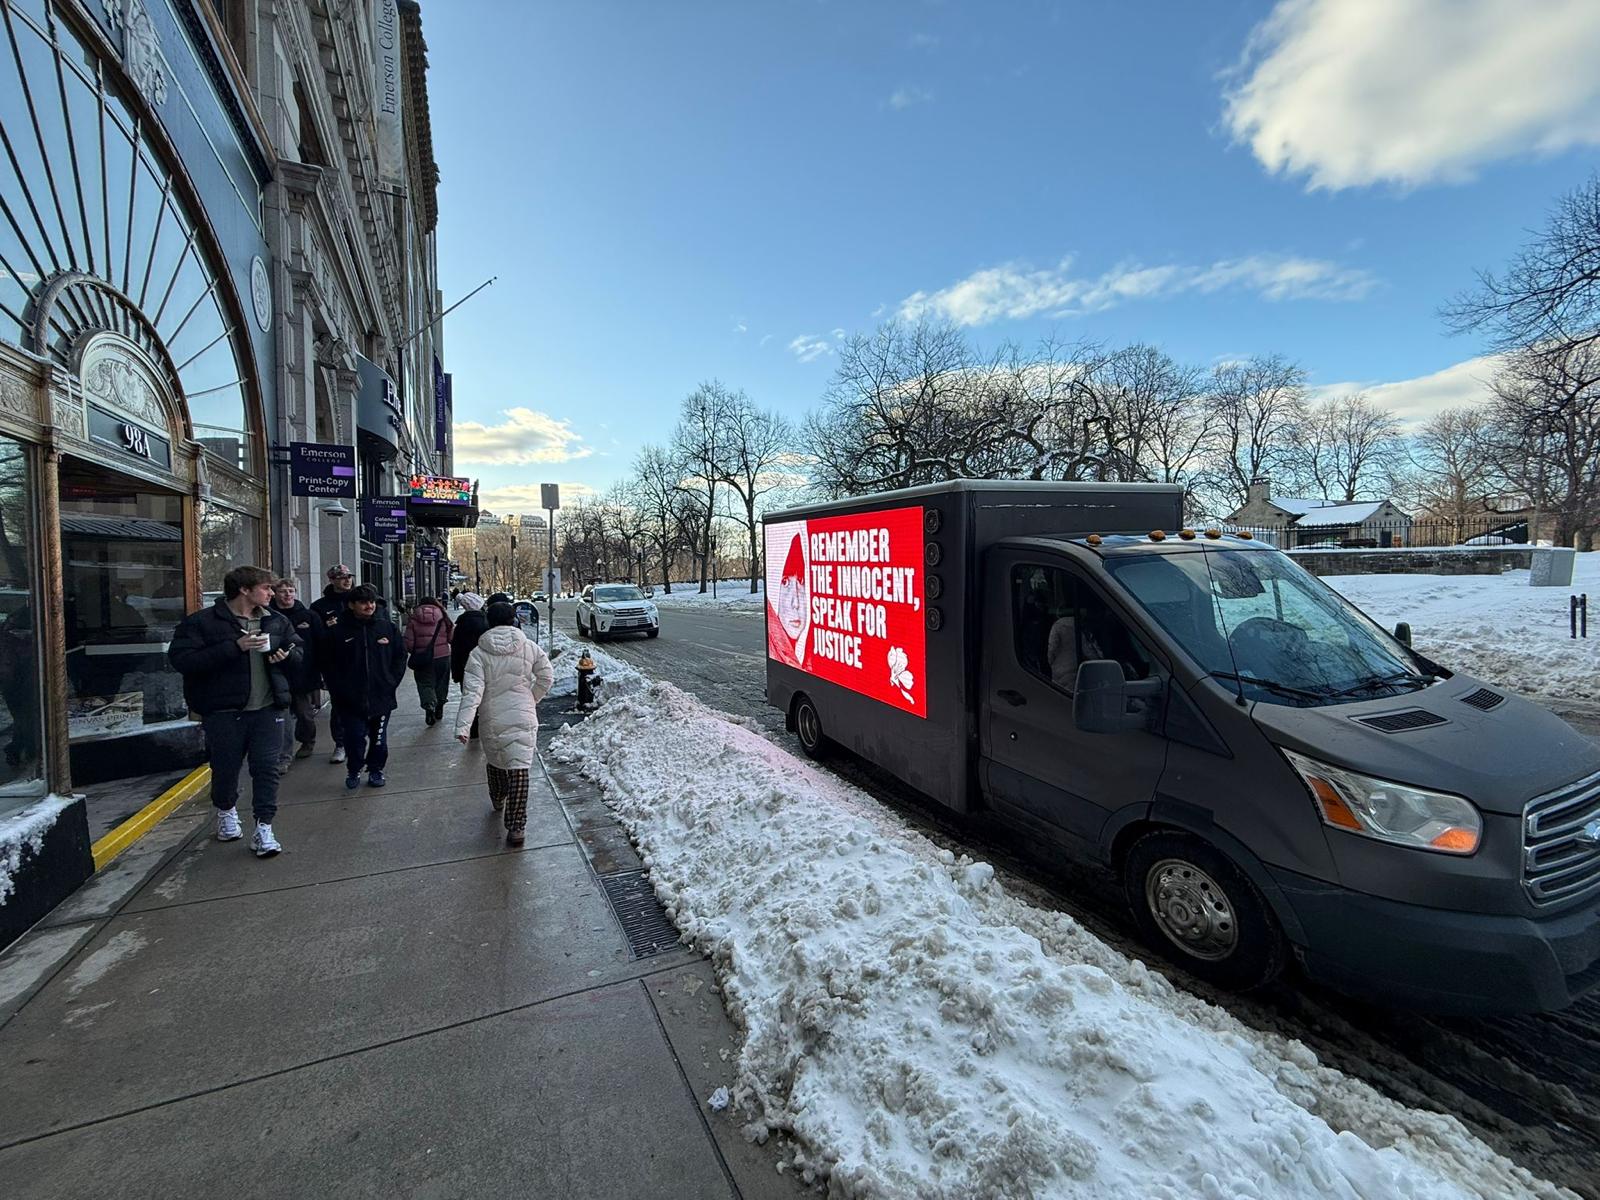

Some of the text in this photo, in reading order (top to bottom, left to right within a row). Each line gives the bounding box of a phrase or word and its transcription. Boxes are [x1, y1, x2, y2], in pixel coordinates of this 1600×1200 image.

[378, 0, 396, 115] Emerson College
[124, 424, 152, 457] 98A
[301, 447, 346, 458] Emerson
[298, 475, 349, 487] Print-Copy
[308, 485, 340, 493] Center
[810, 528, 890, 562] REMEMBER
[811, 565, 920, 612] THE INNOCENT,
[811, 595, 887, 639] SPEAK FOR
[813, 627, 863, 669] JUSTICE
